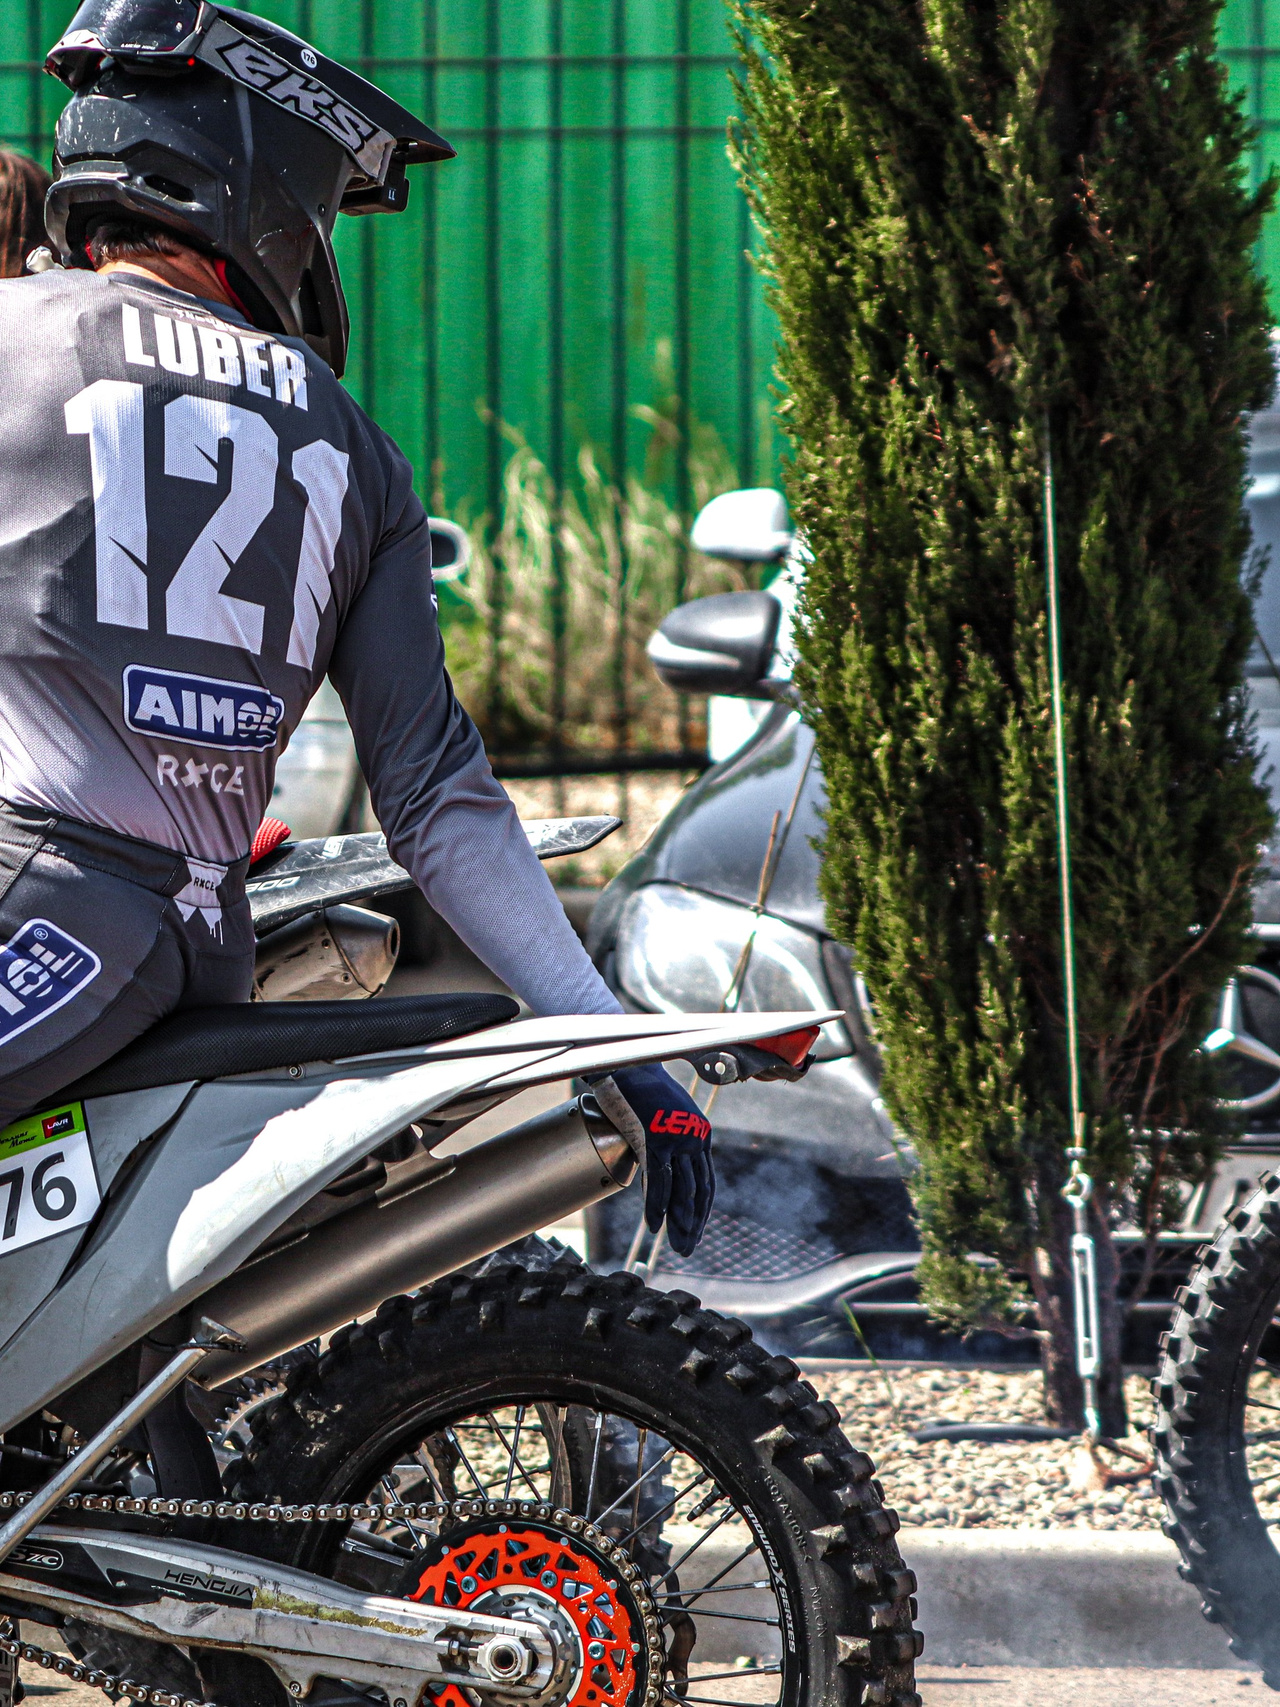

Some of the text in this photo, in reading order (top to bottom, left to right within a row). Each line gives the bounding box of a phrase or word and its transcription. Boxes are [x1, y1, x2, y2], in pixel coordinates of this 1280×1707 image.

[301, 50, 317, 66] 176
[122, 303, 308, 411] LUBER
[64, 379, 349, 670] 121
[47, 1117, 69, 1130] LAVR
[742, 1503, 778, 1565] ENDURO
[778, 1586, 796, 1654] SERIES
